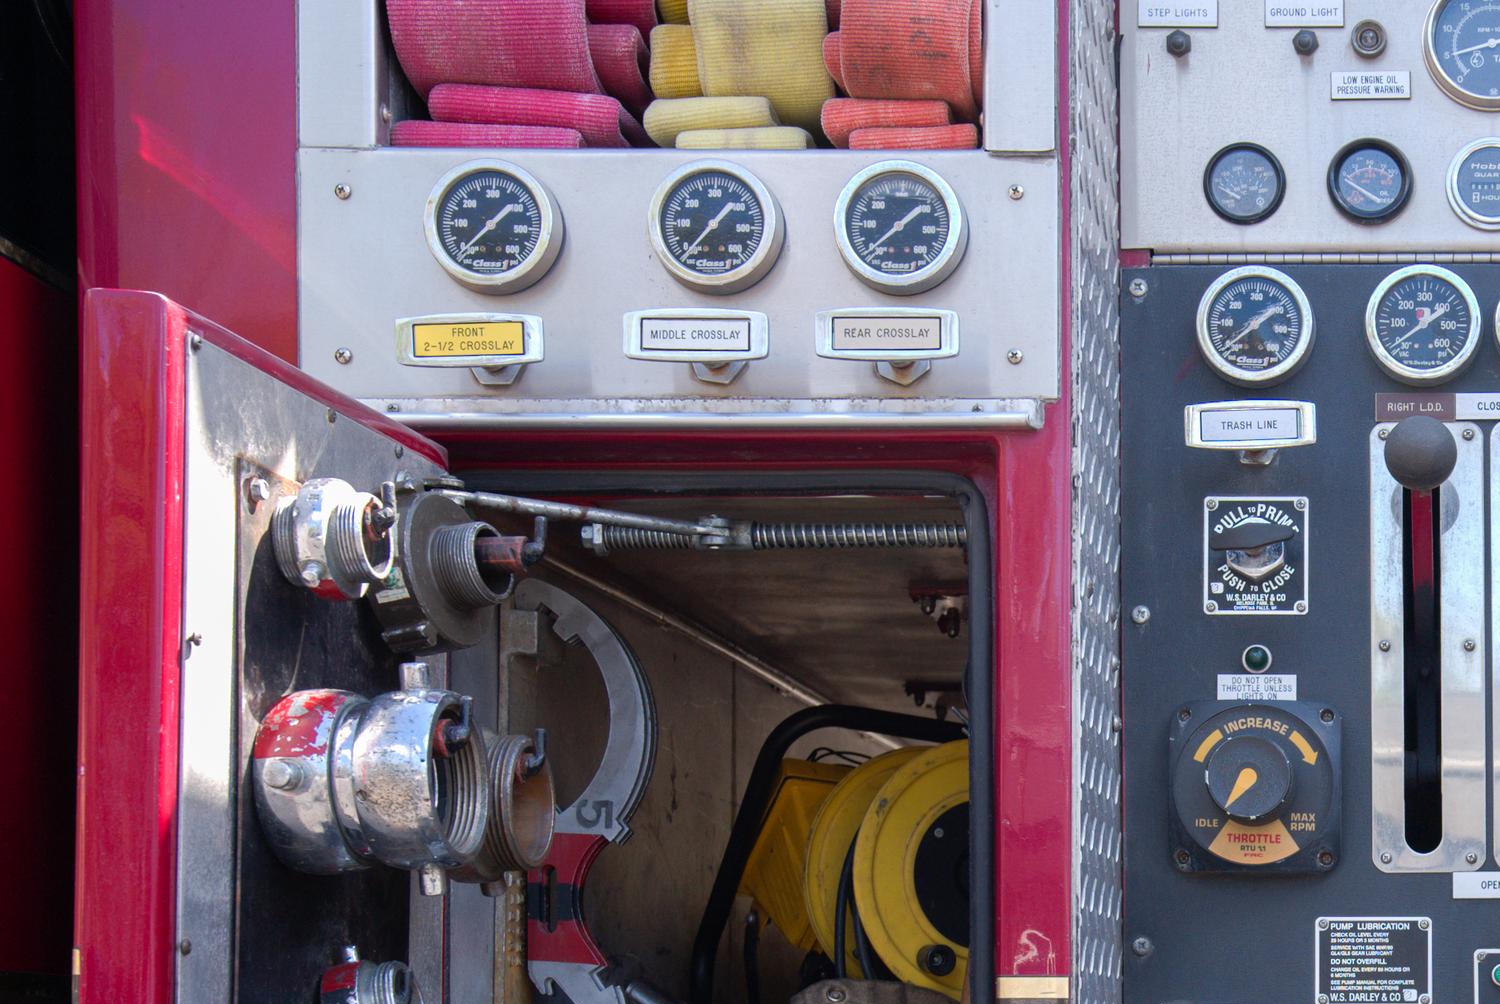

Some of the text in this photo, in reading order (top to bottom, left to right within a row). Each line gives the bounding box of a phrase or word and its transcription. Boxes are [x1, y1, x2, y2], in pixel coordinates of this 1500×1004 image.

[1175, 9, 1208, 17] LIGHTS
[1270, 8, 1338, 16] GROUND LIGHT
[1343, 75, 1398, 84] LOW ENGINE OIL
[1337, 86, 1404, 94] PRESSURE WARNING
[452, 328, 484, 337] FRONT
[651, 329, 740, 340] MIDDLE CROSSLAY
[844, 328, 930, 338] REAR CROSSLAY
[424, 341, 514, 351] 2-1/2 CROSSLAY
[1388, 403, 1443, 411] RIGHT L.D.D.
[1222, 420, 1277, 430] TRASH LINE
[1214, 507, 1248, 534] PULL
[1217, 564, 1295, 593] PUSH CLOSE
[1224, 718, 1289, 735] INCREASE
[1291, 813, 1315, 821] MAX
[1195, 819, 1218, 827] IDLE
[1291, 823, 1315, 831] RPM
[1227, 833, 1280, 843] THROTTLE
[1349, 993, 1400, 1001] DARLEY CO
